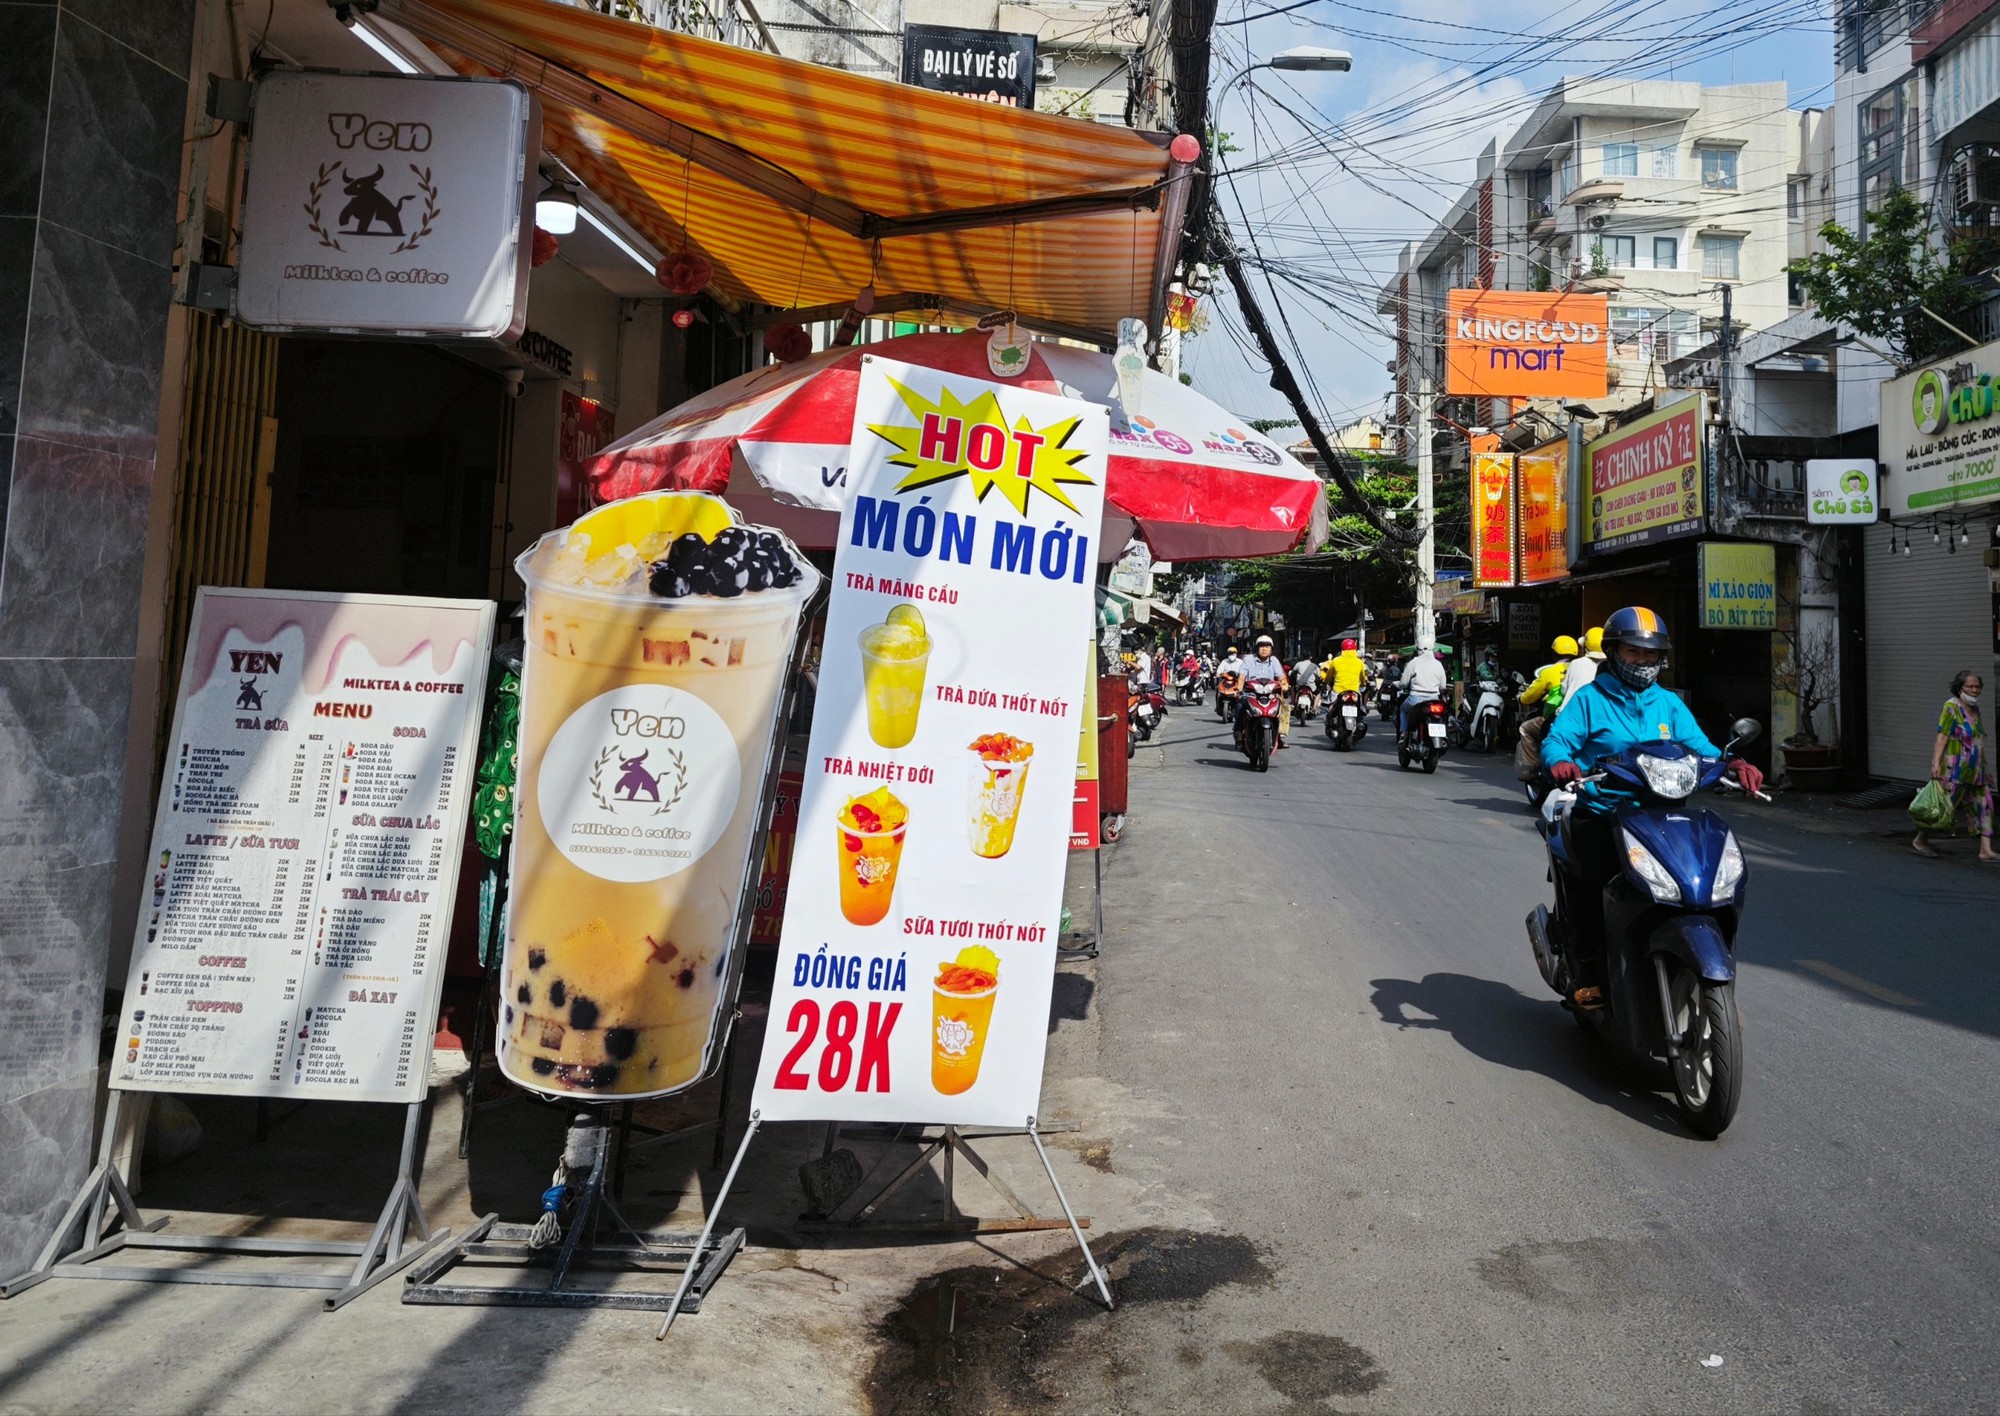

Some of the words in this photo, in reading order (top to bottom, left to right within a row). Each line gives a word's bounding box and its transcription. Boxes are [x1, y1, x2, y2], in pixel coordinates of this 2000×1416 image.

[923, 49, 950, 77] ĐẠI
[953, 49, 972, 75] LÝ
[975, 51, 994, 78] VÉ
[997, 51, 1020, 79] SỐ
[327, 113, 432, 152] Yen
[367, 269, 381, 282] &
[1457, 318, 1599, 343] KINGFOOD
[1490, 343, 1565, 371] mart
[918, 413, 1045, 477] HOT
[1607, 441, 1650, 487] CHINH
[850, 495, 977, 565] MÓN
[989, 519, 1088, 584] MỚI
[847, 572, 874, 591] TRÀ
[879, 578, 924, 599] MÃNG
[929, 584, 959, 605] CẦU
[1708, 579, 1720, 598] MÌ
[1723, 579, 1744, 599] XÀO
[1747, 579, 1773, 599] GIÒN
[1708, 605, 1724, 625] BÒ
[1751, 603, 1774, 626] TẾT
[228, 649, 283, 674] YEN
[343, 678, 400, 691] MILKTEA
[403, 681, 412, 692] &
[415, 682, 464, 694] COFFEE
[313, 702, 373, 719] MENU
[937, 685, 963, 703] TRÀ
[968, 688, 997, 708] DỨA
[1002, 690, 1036, 712] THỐT
[1041, 695, 1068, 717] NỐT
[235, 718, 261, 729] TRÀ
[393, 726, 427, 738] SODA
[610, 708, 686, 739] Yen
[824, 757, 851, 775] TRÀ
[858, 761, 904, 783] NHIỆT
[908, 765, 934, 784] ĐỚI
[352, 813, 376, 827] SỮA
[380, 816, 413, 828] CHUA
[415, 815, 441, 830] LẮC
[632, 826, 641, 837] &
[185, 833, 228, 847] LATTE
[240, 832, 265, 848] SỮA
[269, 837, 300, 850] TƯƠI
[341, 887, 367, 900] TRÀ
[371, 887, 401, 902] TRÁI
[403, 889, 430, 903] CÂY
[904, 915, 935, 935] SỮA
[939, 919, 973, 938] TƯƠI
[978, 919, 1014, 940] THỐT
[1017, 920, 1046, 943] NỐT
[198, 955, 247, 968] COFFEE
[793, 943, 862, 989] ĐỒNG
[868, 952, 907, 992] GIÁ
[187, 1000, 243, 1013] TOPPING
[348, 988, 366, 1002] ĐÁ
[370, 991, 398, 1004] XAY
[773, 999, 903, 1094] 28K
